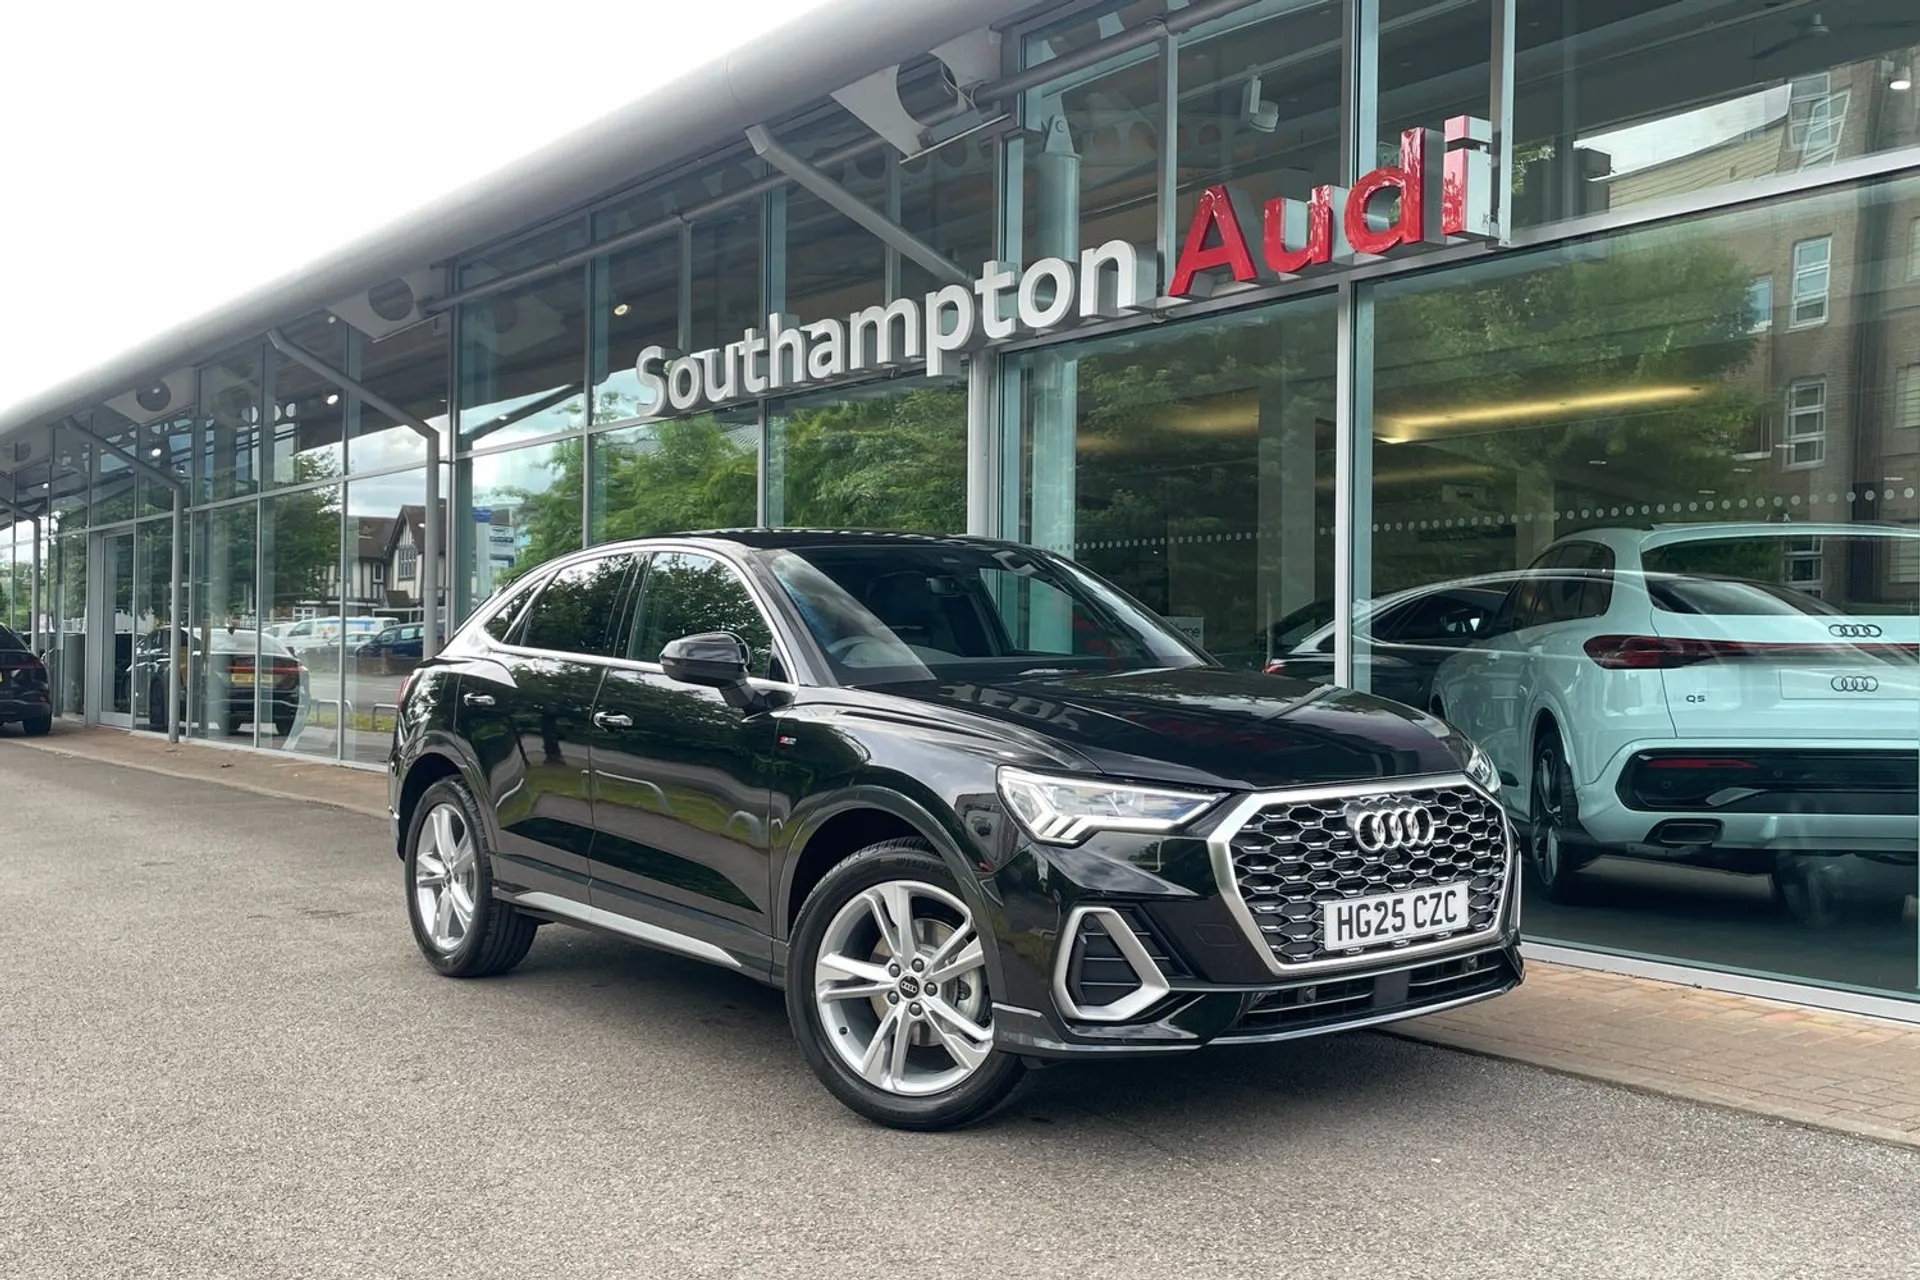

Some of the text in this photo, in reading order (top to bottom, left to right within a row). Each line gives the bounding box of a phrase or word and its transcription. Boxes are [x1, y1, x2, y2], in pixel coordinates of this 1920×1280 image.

[635, 114, 1490, 417] Southampton Audi
[1685, 694, 1706, 704] Q5
[1336, 889, 1458, 942] HG25 CZC
